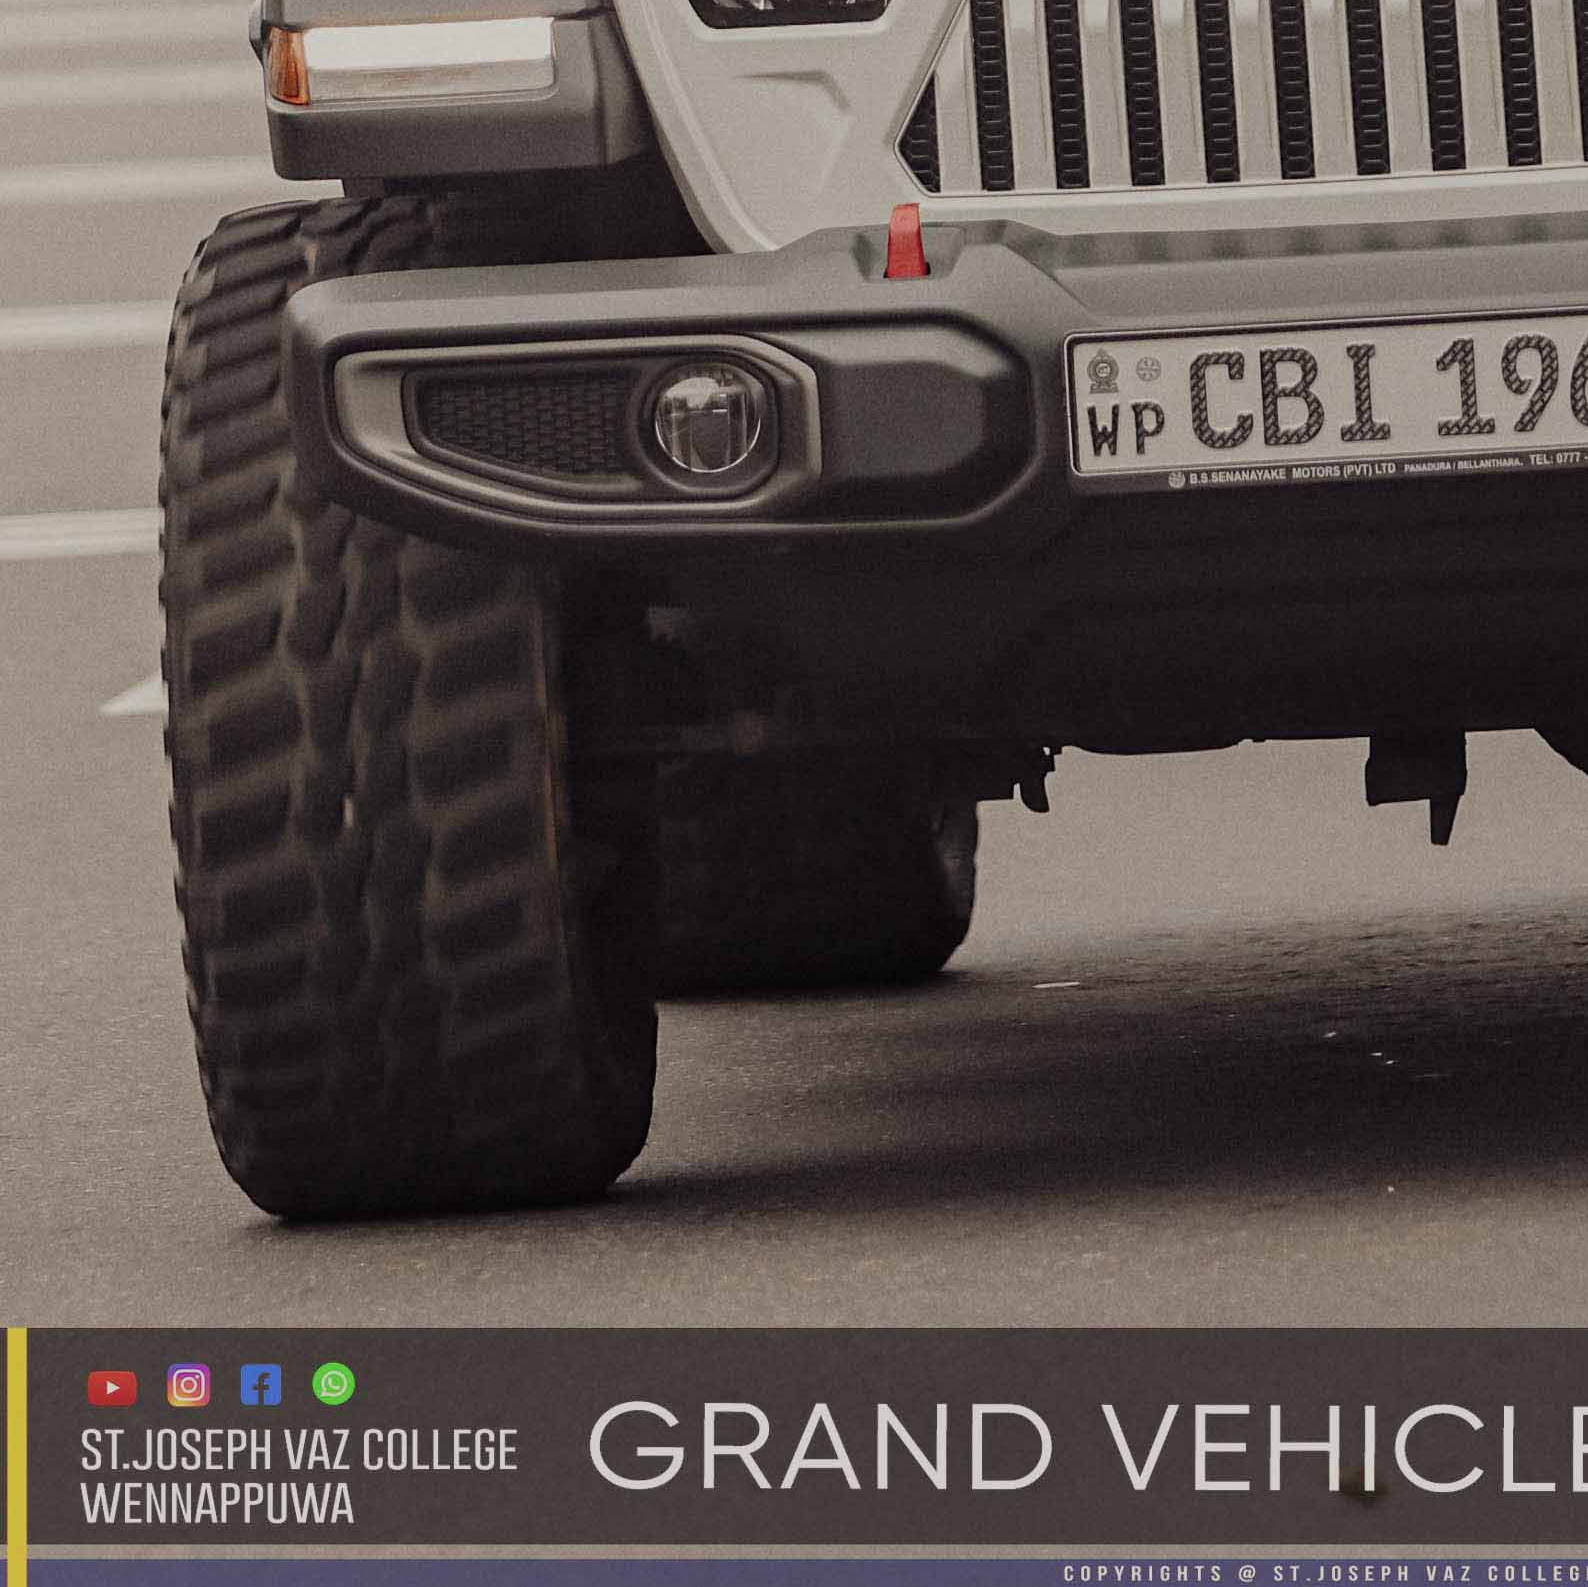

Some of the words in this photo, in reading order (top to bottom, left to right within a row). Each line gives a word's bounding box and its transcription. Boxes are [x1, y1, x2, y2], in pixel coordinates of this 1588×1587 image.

[1087, 402, 1165, 456] WP
[1189, 343, 1391, 448] CBI
[1292, 466, 1341, 479] MOTORS
[1343, 464, 1373, 479] (PVT)
[1375, 463, 1396, 475] LTD
[1404, 462, 1451, 474] PANADURA
[1529, 453, 1554, 466] TEL:
[1556, 451, 1581, 464] 0777
